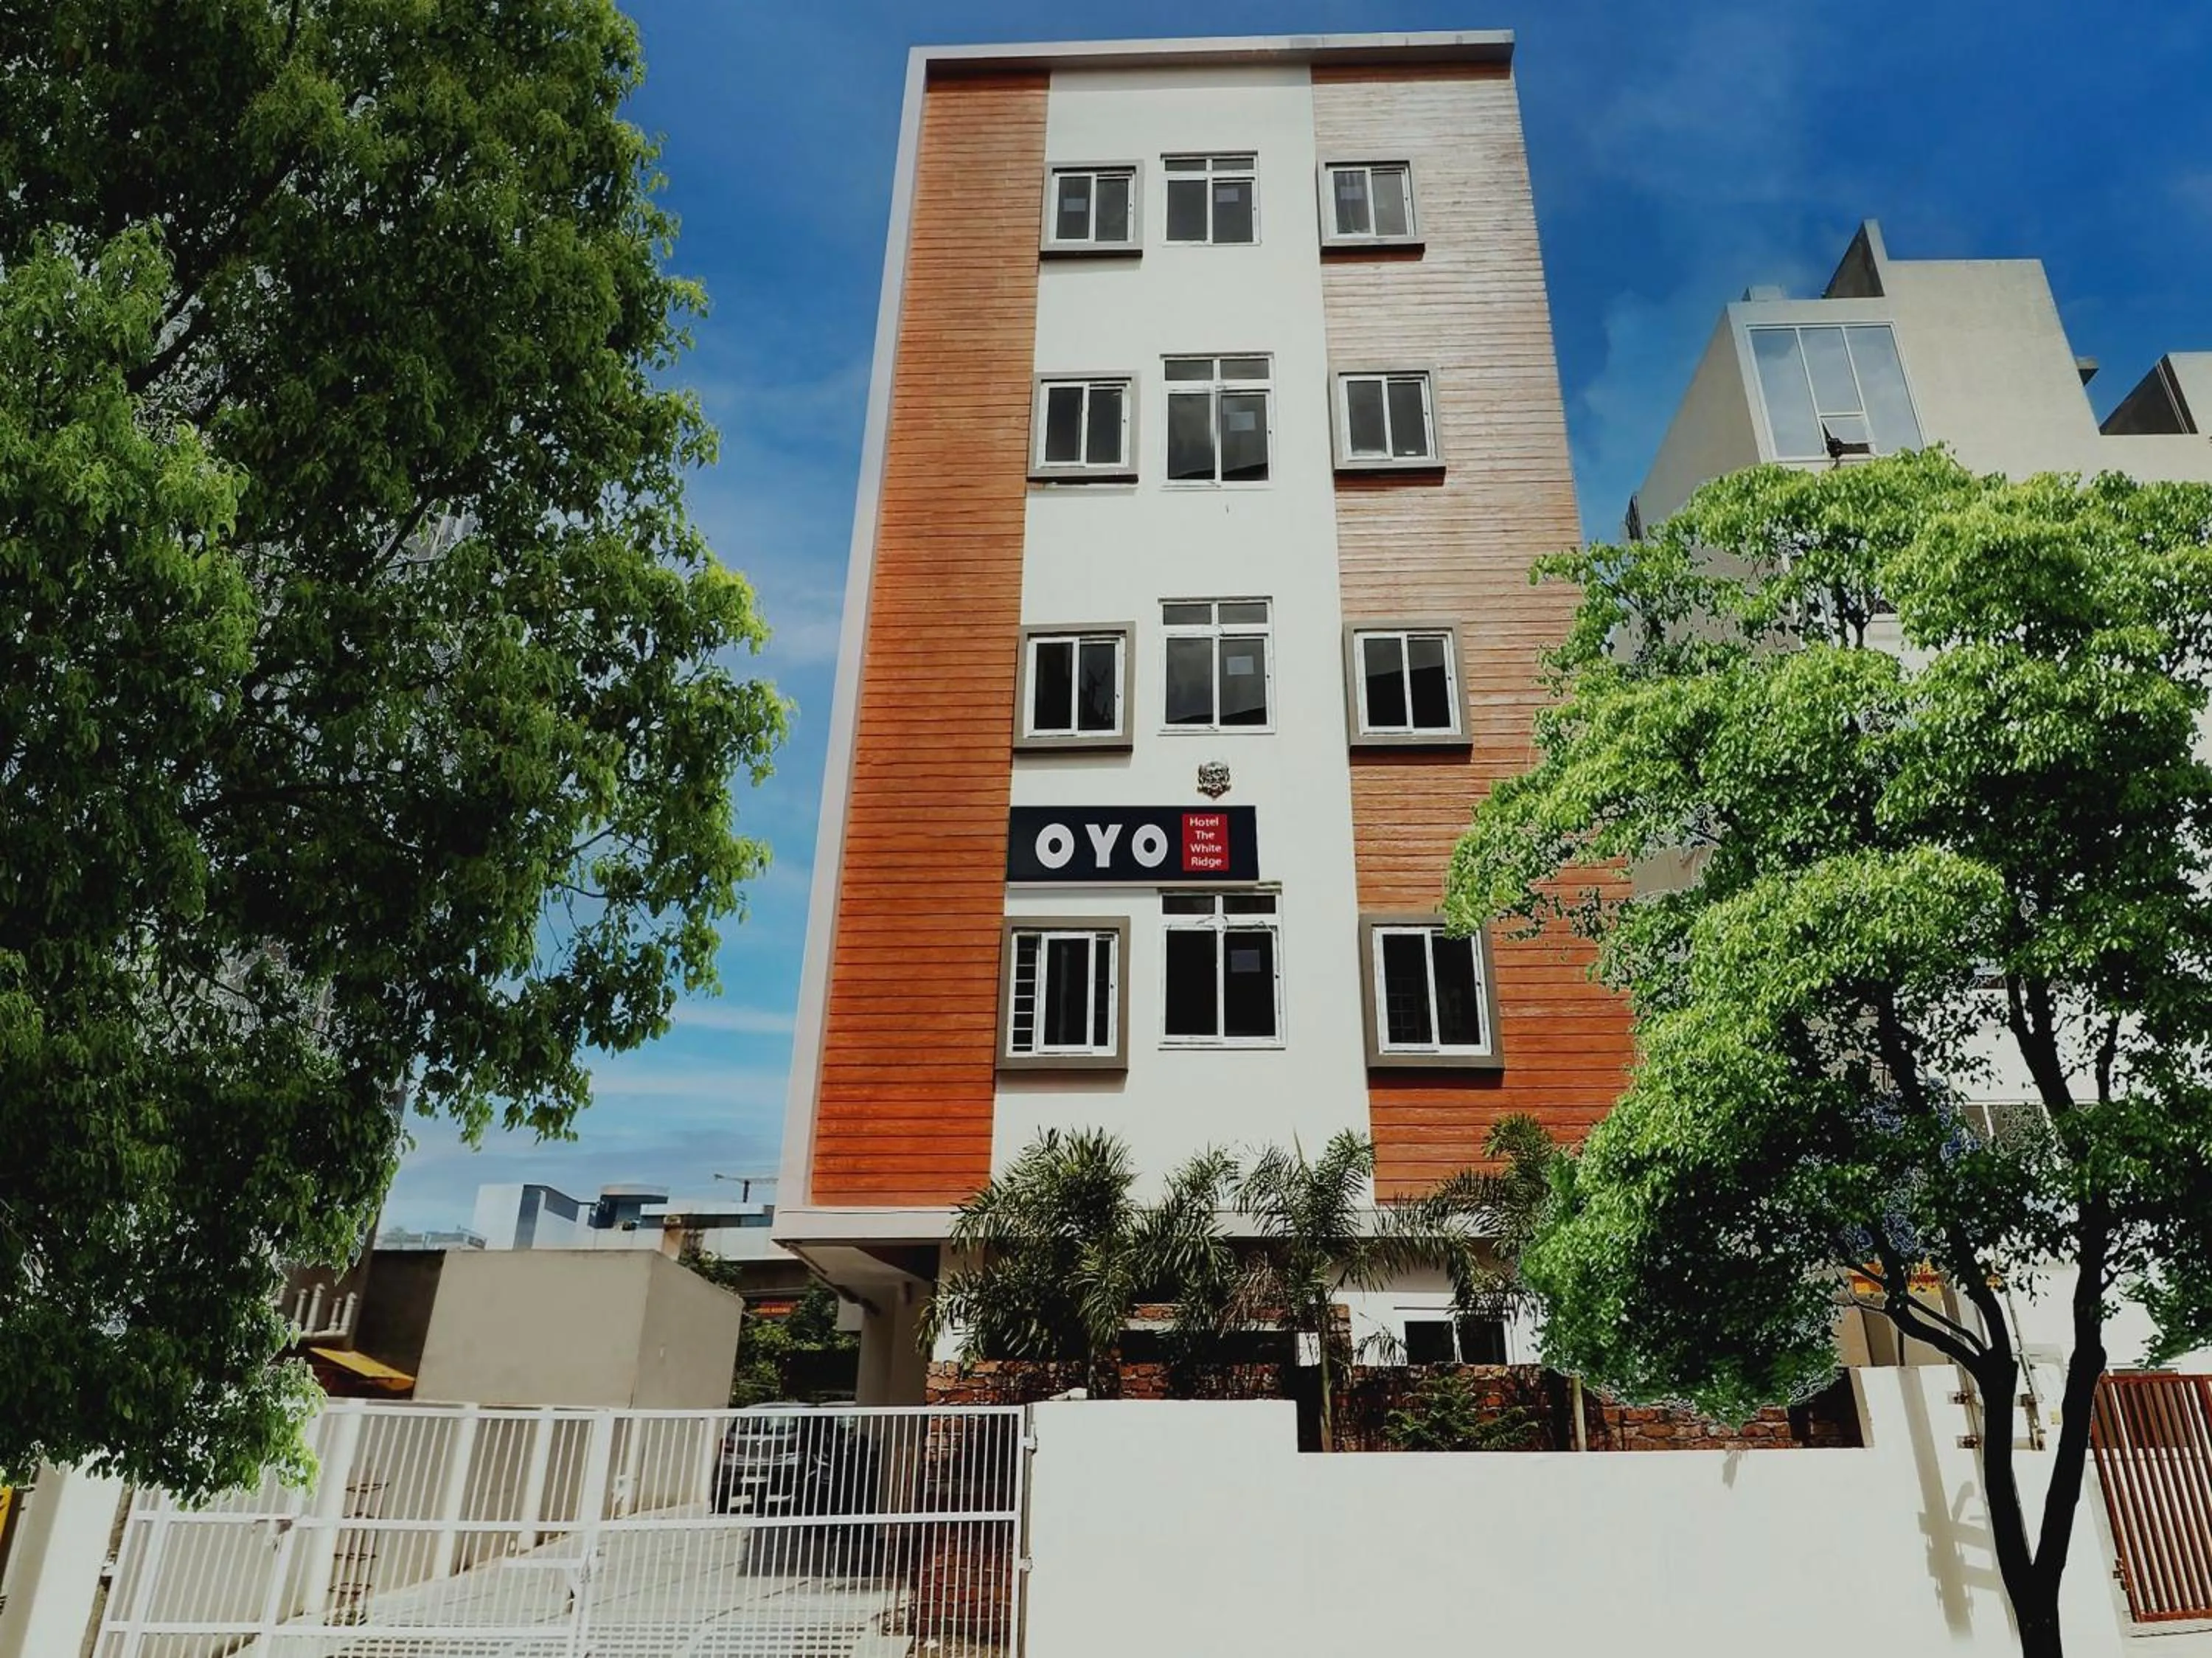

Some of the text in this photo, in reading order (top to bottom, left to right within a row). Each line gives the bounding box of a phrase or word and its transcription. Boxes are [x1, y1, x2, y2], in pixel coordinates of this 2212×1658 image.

[1189, 816, 1220, 826] Hotel
[1195, 830, 1215, 839] The
[1035, 823, 1168, 869] OYO
[1189, 843, 1222, 853] White
[1191, 856, 1222, 868] Ridge
